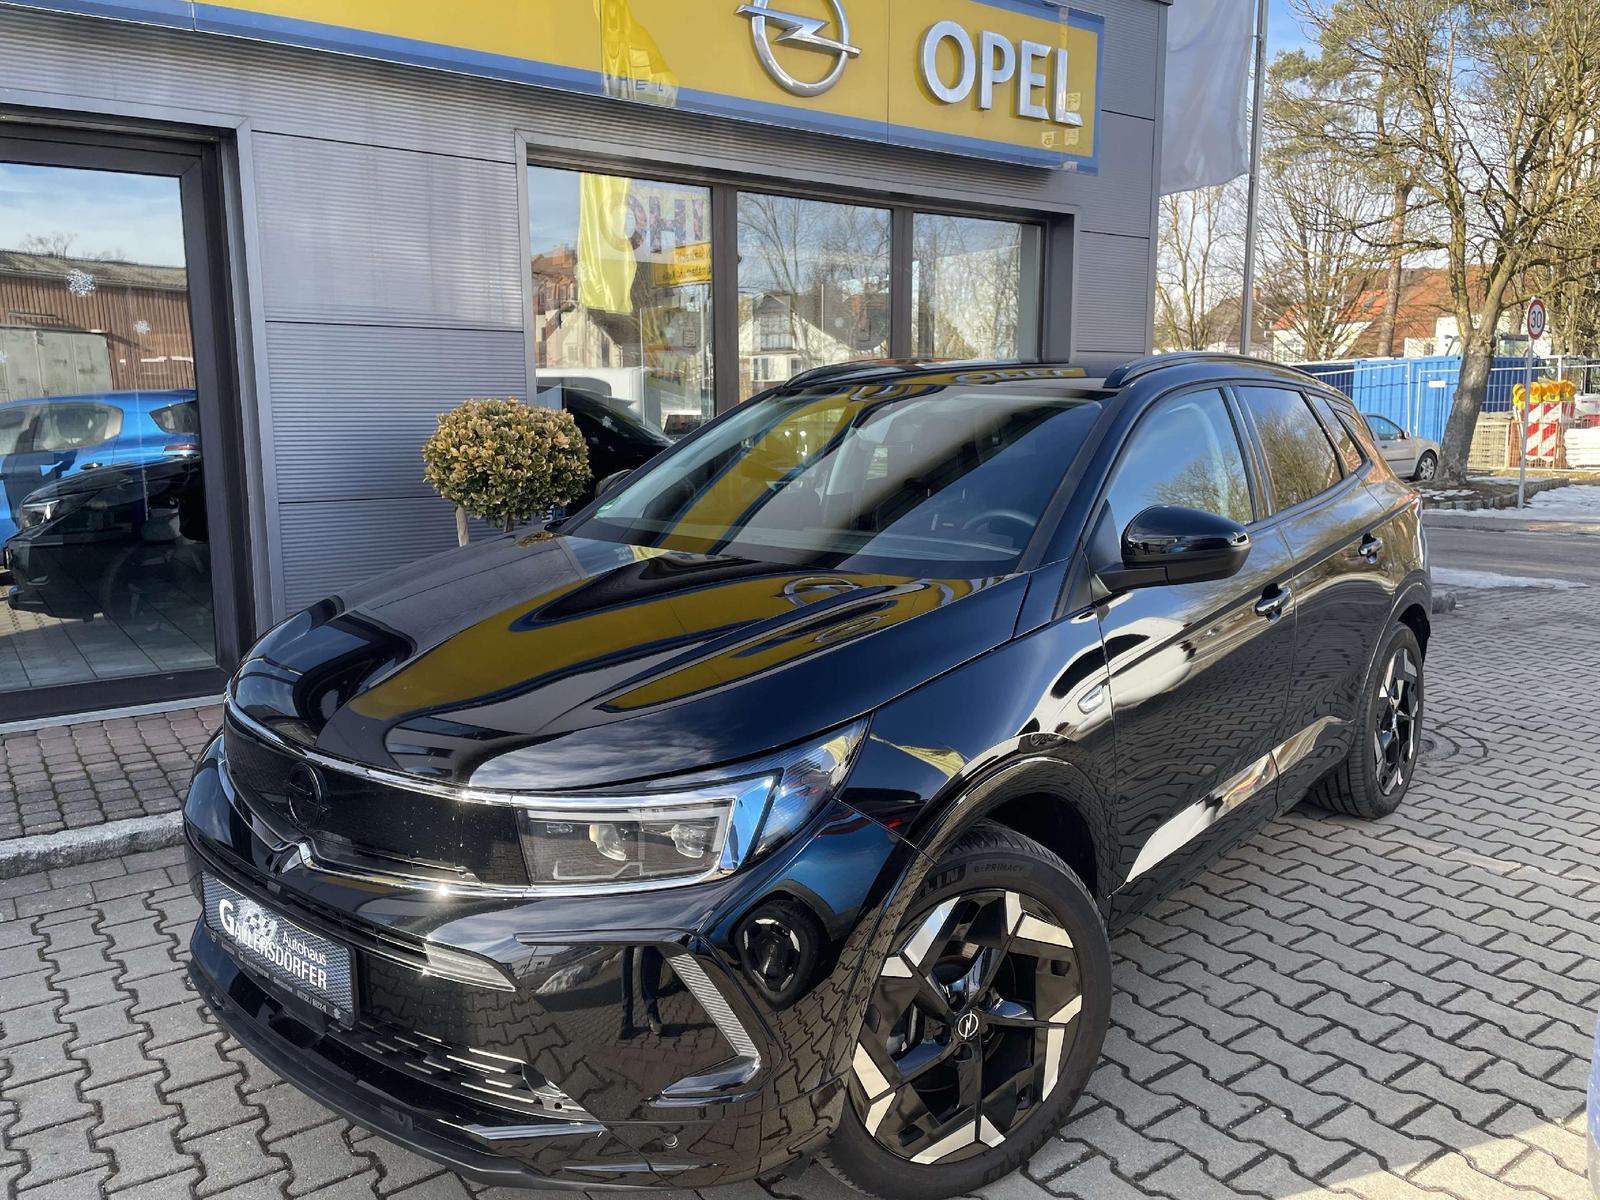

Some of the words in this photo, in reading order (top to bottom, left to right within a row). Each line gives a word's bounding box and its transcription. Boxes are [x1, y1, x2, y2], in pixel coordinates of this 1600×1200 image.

[921, 20, 1083, 127] OPEL
[1530, 310, 1543, 329] 30
[282, 931, 327, 966] Autohaus
